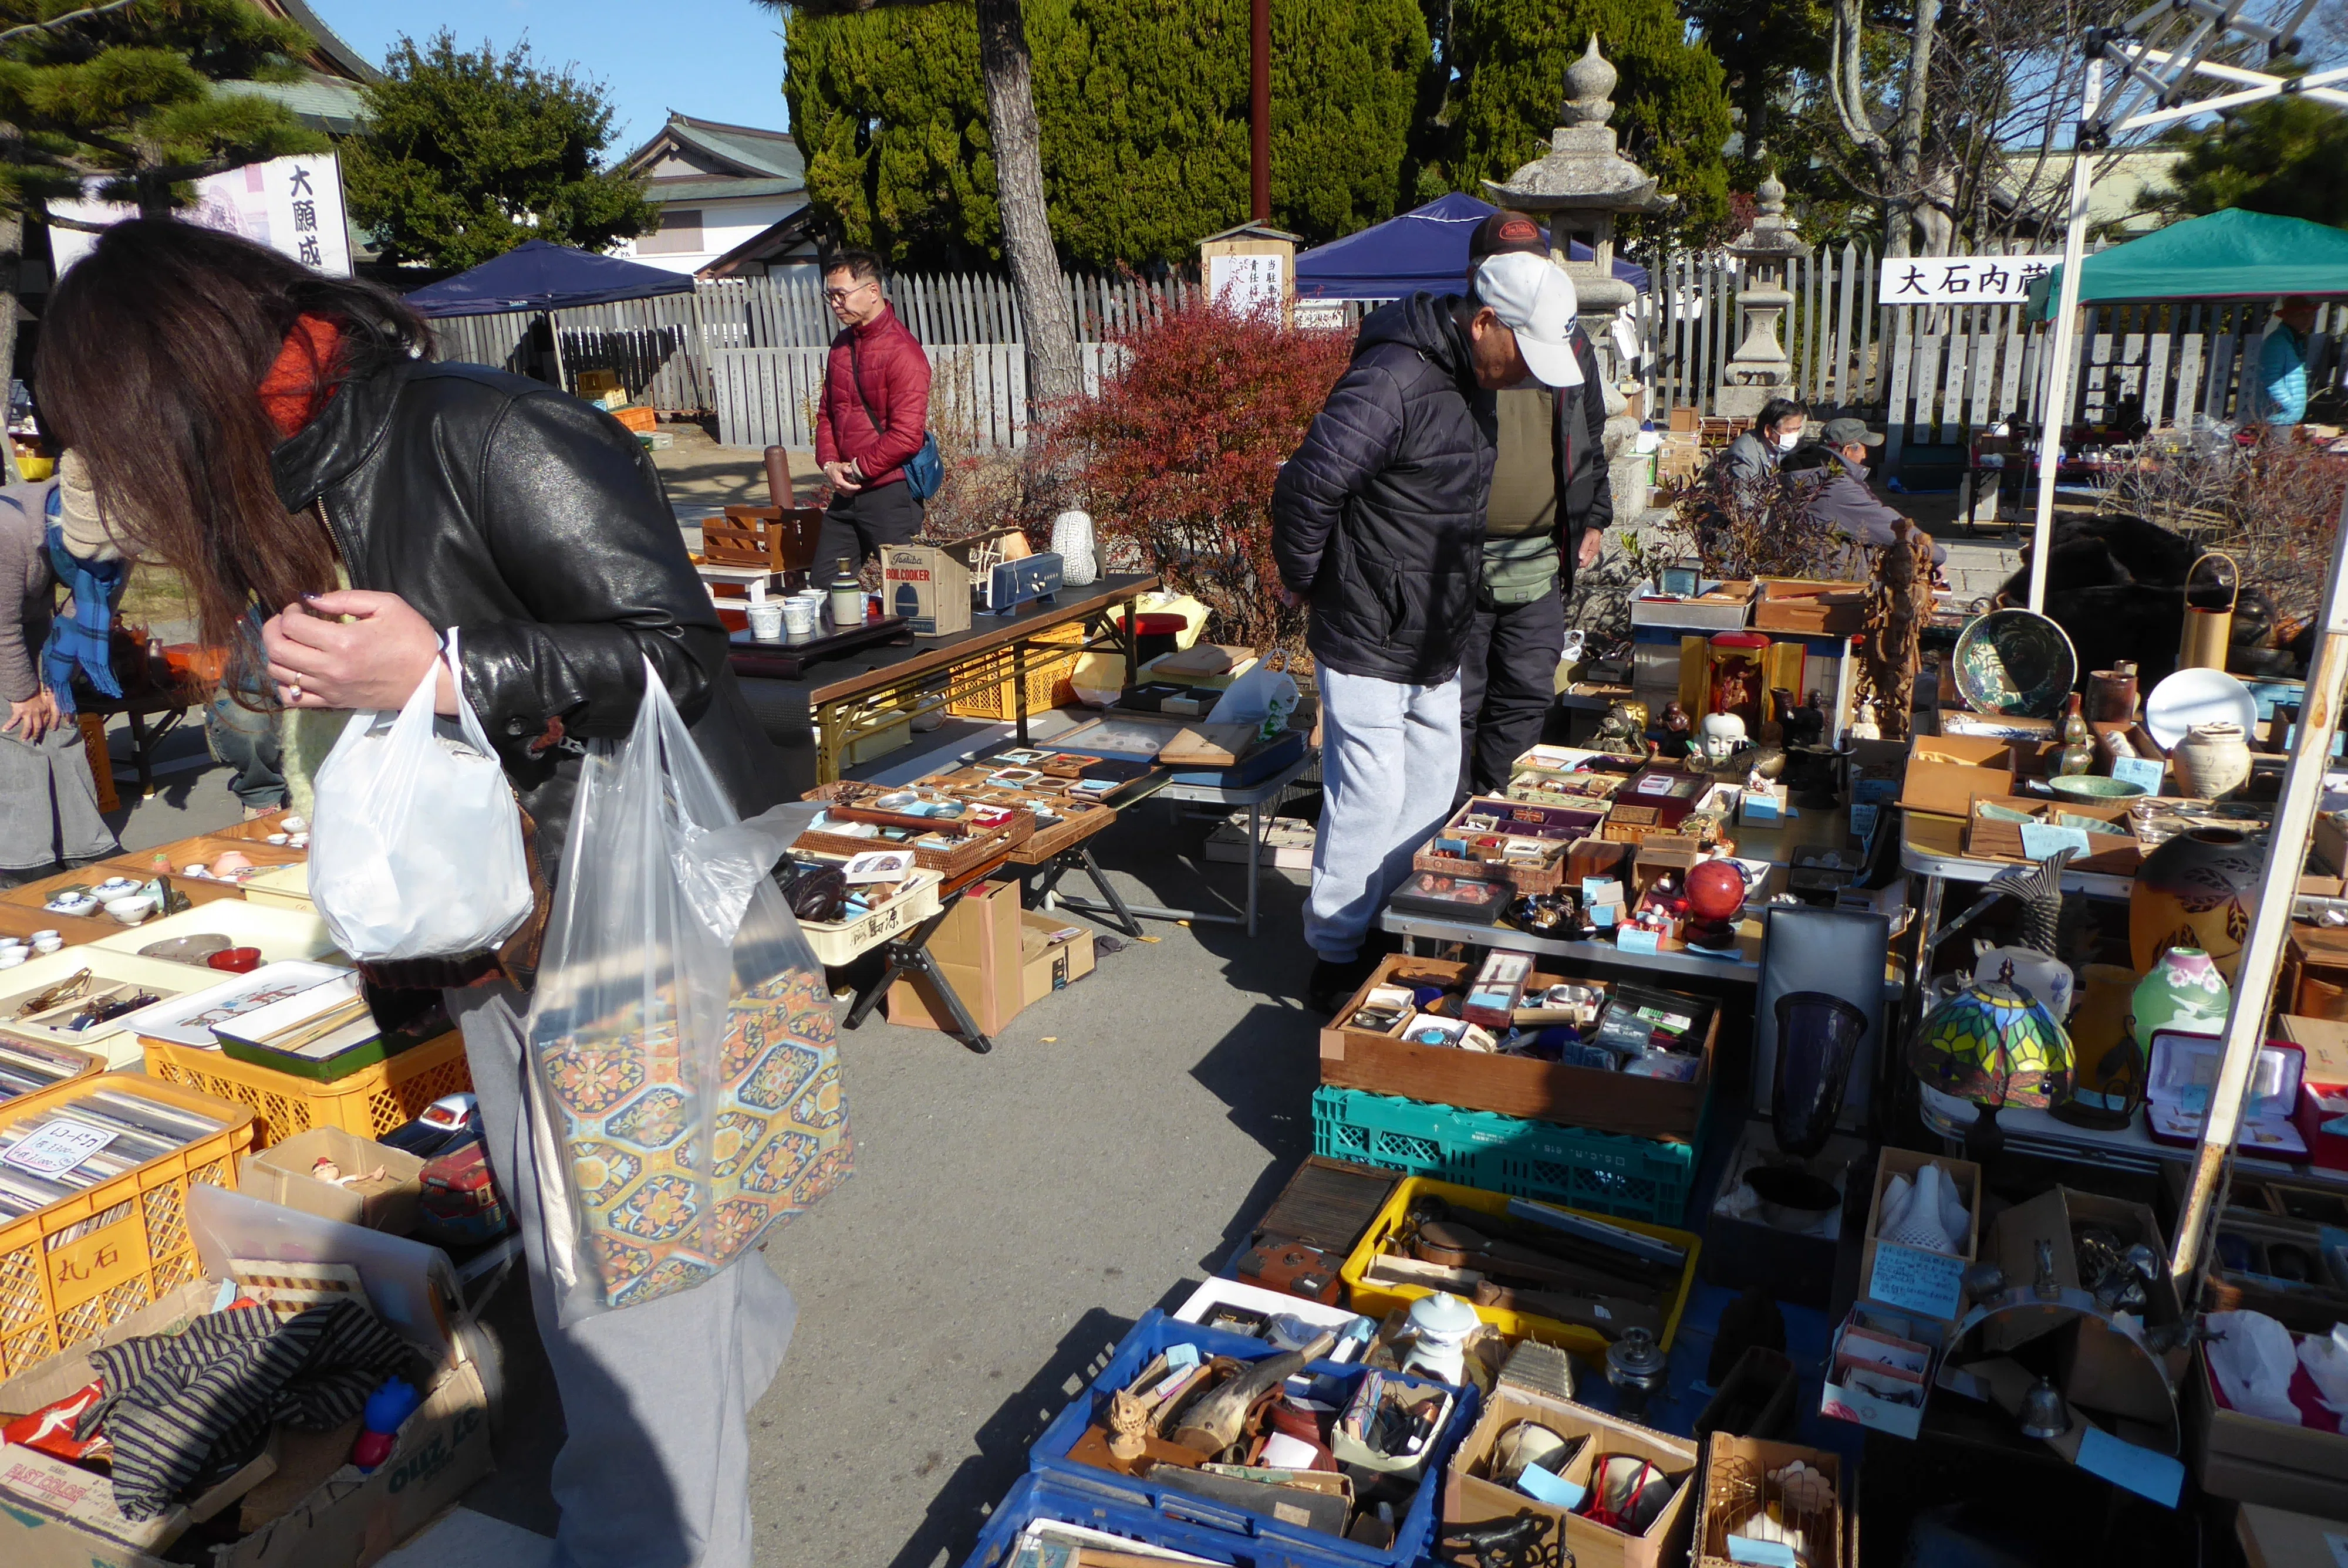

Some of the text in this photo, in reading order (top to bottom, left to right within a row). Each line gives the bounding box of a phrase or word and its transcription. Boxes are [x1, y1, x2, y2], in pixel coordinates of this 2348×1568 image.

[289, 164, 322, 265] 大願成
[891, 552, 923, 565] Toshiba
[57, 1242, 118, 1288] 丸石
[39, 1476, 87, 1502] COLOR
